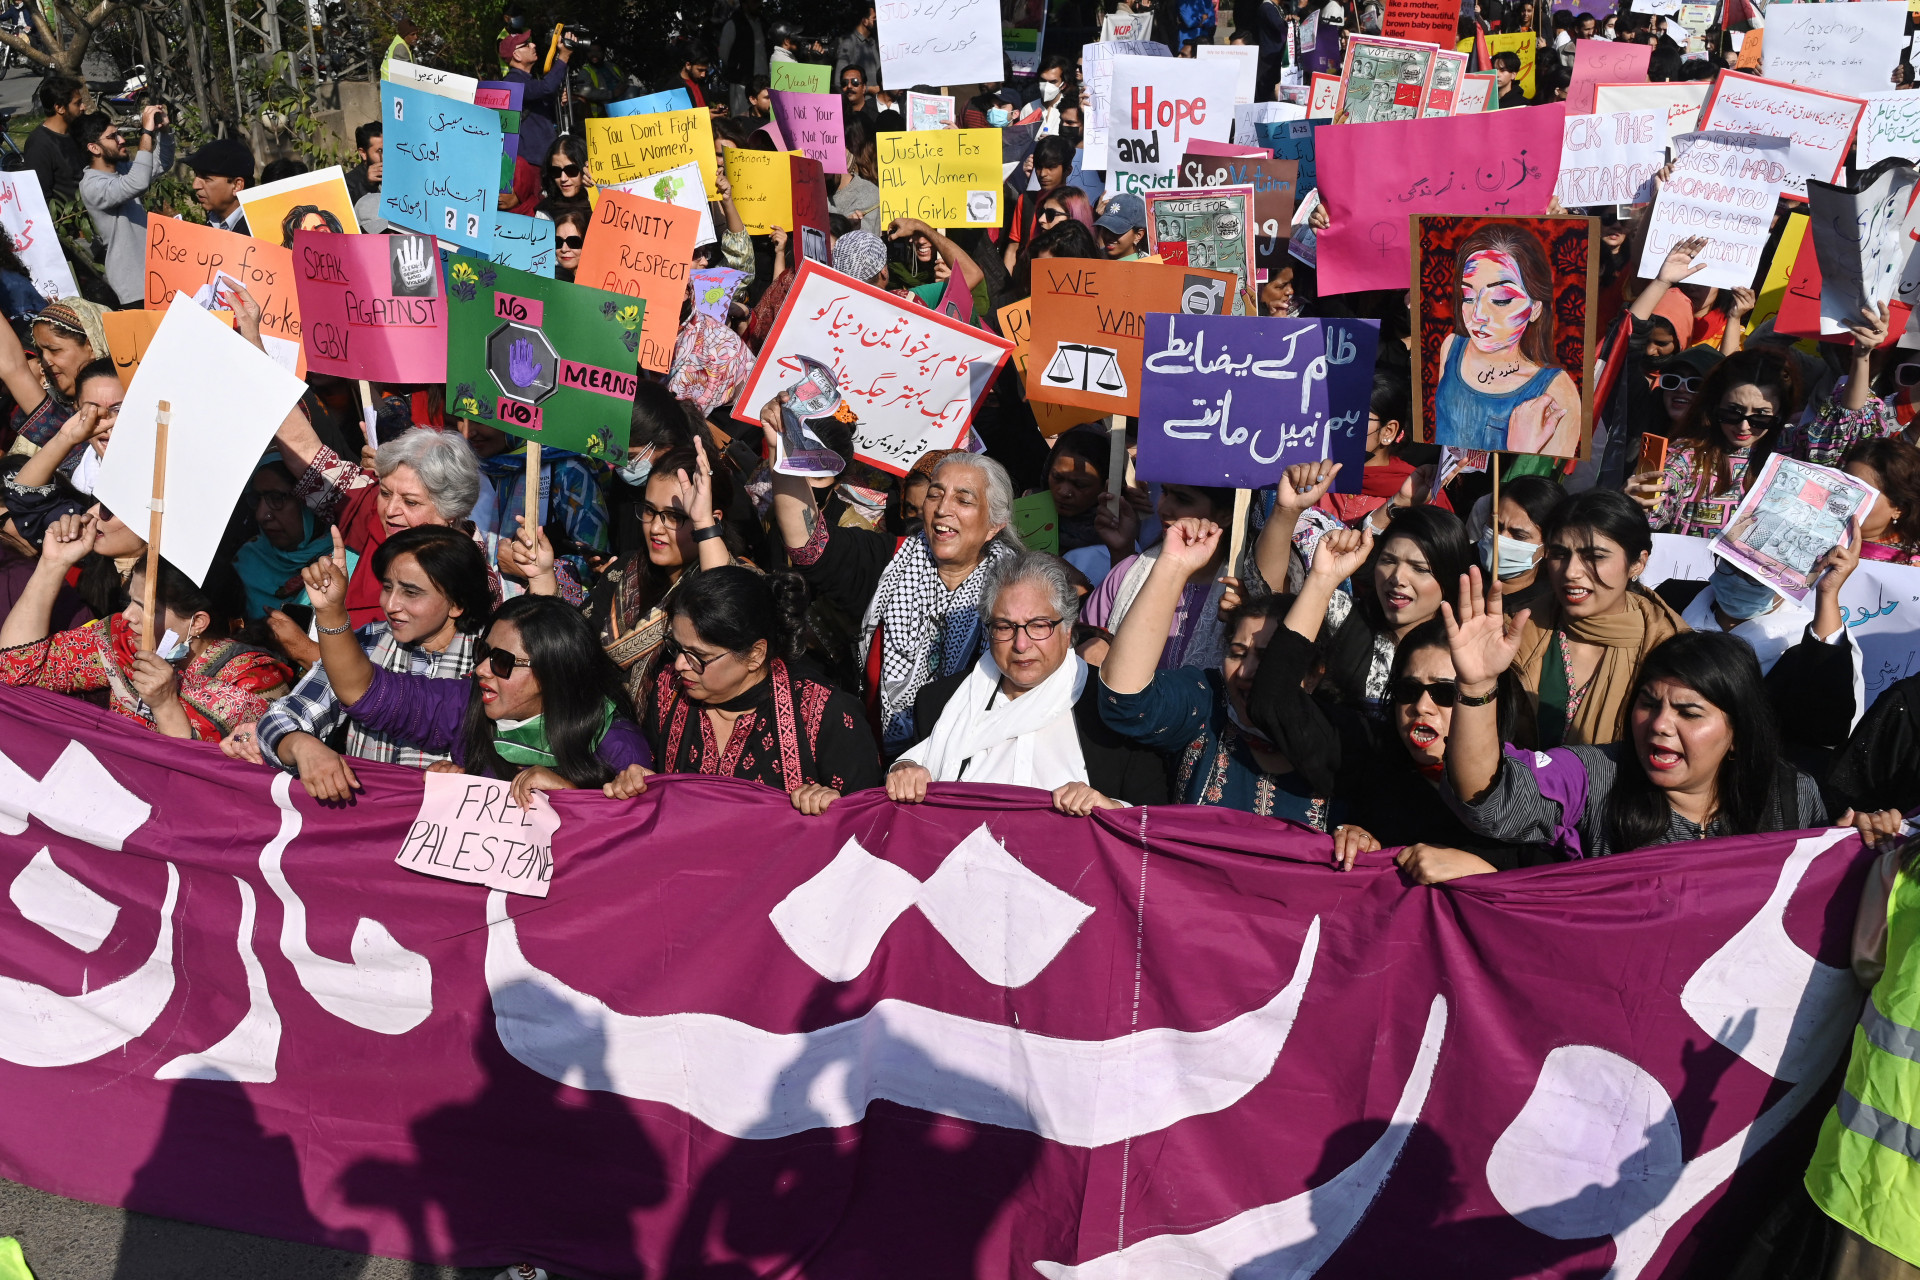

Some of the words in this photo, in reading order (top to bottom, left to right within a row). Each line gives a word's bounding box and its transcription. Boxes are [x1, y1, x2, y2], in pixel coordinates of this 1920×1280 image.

[1398, 12, 1419, 20] every
[1420, 12, 1456, 21] beautiful,
[1409, 1, 1440, 10] mother,
[1113, 25, 1132, 36] NCJP
[1384, 29, 1406, 38] killed
[1386, 20, 1411, 28] brown
[1411, 21, 1431, 30] baby
[1432, 23, 1453, 31] being
[1367, 47, 1396, 58] VOTE
[1397, 51, 1417, 61] FOR
[813, 105, 836, 123] Your
[1130, 85, 1206, 143] Hope
[601, 125, 624, 147] You
[630, 120, 664, 142] Don't
[669, 114, 699, 143] Fight
[801, 130, 817, 144] Not
[819, 130, 839, 146] Your
[1291, 125, 1308, 135] A-25
[1563, 116, 1603, 152] CK
[1611, 112, 1655, 146] THE
[1675, 133, 1711, 155] NO
[1713, 134, 1758, 155] ONE
[588, 158, 605, 175] For
[610, 151, 633, 172] ALL
[639, 142, 694, 163] Women,
[880, 136, 945, 165] Justice
[958, 133, 981, 156] For
[1116, 129, 1160, 164] and
[919, 162, 978, 187] Women
[1114, 168, 1176, 197] resist
[1184, 160, 1229, 188] Stop
[1720, 154, 1738, 177] A
[1739, 158, 1786, 184] MAD
[881, 197, 910, 223] And
[917, 194, 958, 220] Girls
[1169, 202, 1201, 213] VOTE
[1204, 200, 1230, 212] FOR
[1662, 176, 1736, 203] WOMAN
[1736, 186, 1769, 211] YOU
[600, 199, 674, 240] DIGNITY
[1655, 201, 1722, 229] MADE
[1723, 212, 1762, 236] HER
[150, 223, 188, 263] Rise
[196, 252, 224, 285] up
[237, 245, 278, 286] for
[303, 246, 350, 282] SPEAK
[619, 244, 689, 282] RESPECT
[601, 270, 642, 299] AND
[1047, 269, 1099, 296] WE
[344, 290, 437, 326] AGAINST
[497, 296, 528, 321] NO
[809, 294, 851, 321] کو
[827, 305, 864, 339] دنیا
[312, 322, 350, 360] GBV
[860, 316, 931, 359] خواتین
[1251, 322, 1318, 380] کے
[640, 338, 671, 373] ALL!
[930, 353, 983, 381] کام
[1300, 325, 1357, 415] ظلم
[564, 365, 638, 396] MEANS
[500, 401, 540, 428] NO!
[1163, 388, 1249, 446] مانتے
[1248, 411, 1322, 465] نہیں
[1319, 409, 1361, 465] ہم
[1796, 465, 1824, 484] VOTE
[1827, 480, 1850, 496] FOR
[455, 784, 538, 827] FREE
